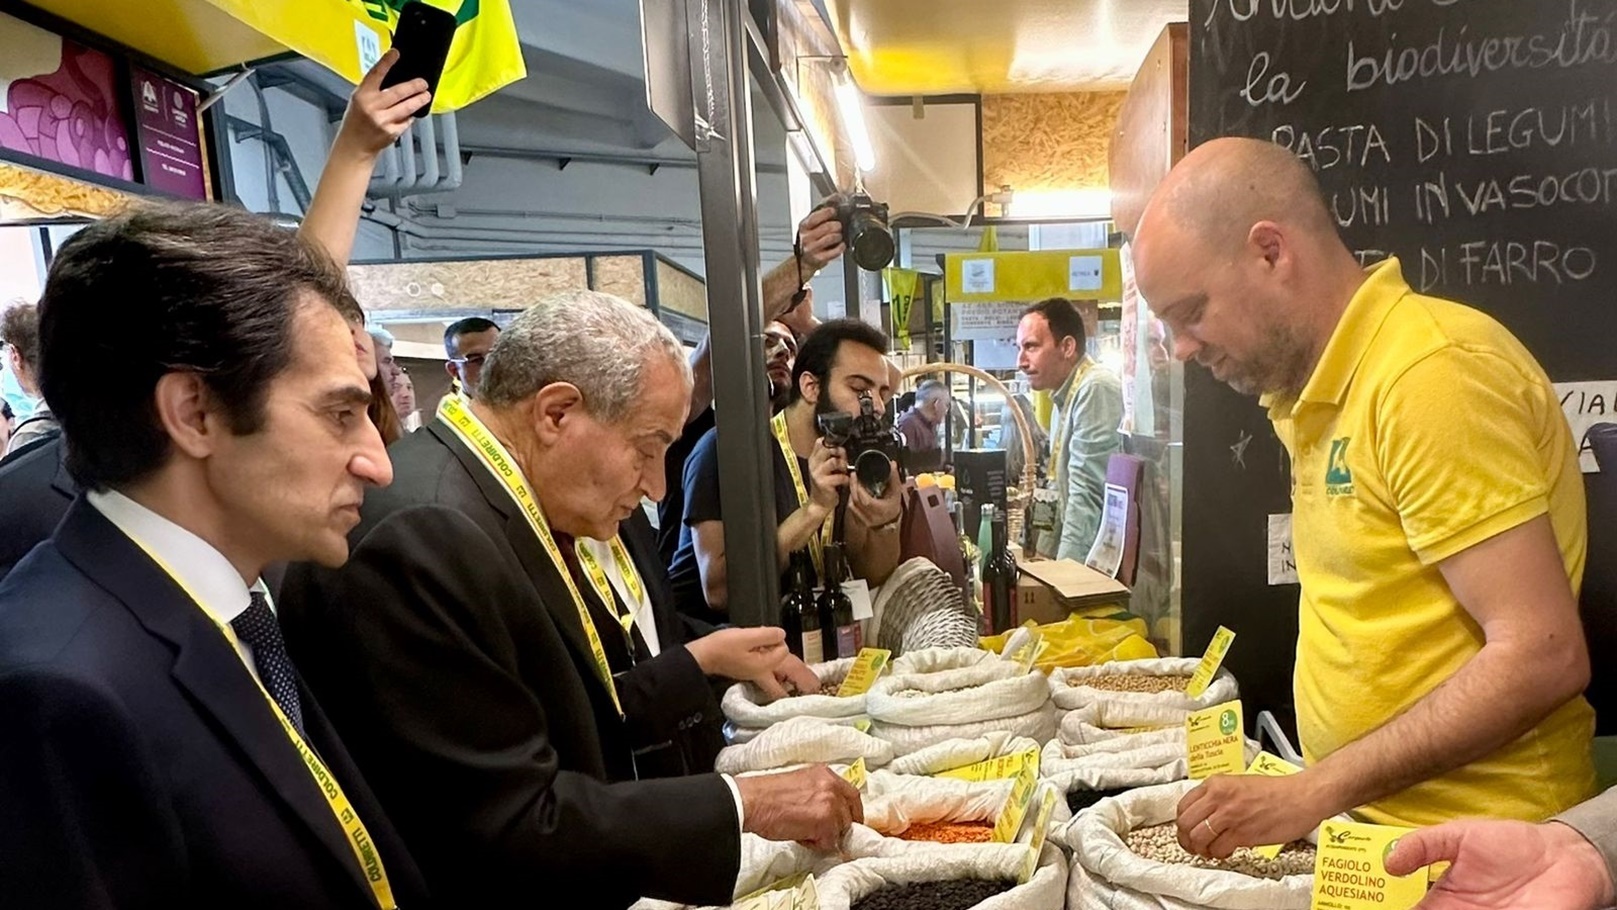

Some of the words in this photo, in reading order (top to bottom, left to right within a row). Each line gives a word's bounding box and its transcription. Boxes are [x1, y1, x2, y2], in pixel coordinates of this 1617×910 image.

[1239, 52, 1306, 106] la
[1271, 124, 1390, 170] PASTA
[1415, 116, 1451, 162] DI
[1467, 98, 1611, 155] LEGUMI
[1331, 186, 1389, 227] UMI
[1420, 247, 1448, 292] DI
[1461, 241, 1597, 286] FARRO
[472, 428, 513, 477] COLDIRETTI
[1222, 712, 1230, 728] 8
[1223, 735, 1239, 745] NERA
[296, 740, 339, 800] COLDIRETTI
[352, 827, 381, 882] COLDIRETTI
[1322, 856, 1371, 873] FAGIOLO
[1319, 884, 1385, 903] AQUESIANO
[1321, 870, 1386, 889] VERDOLINO
